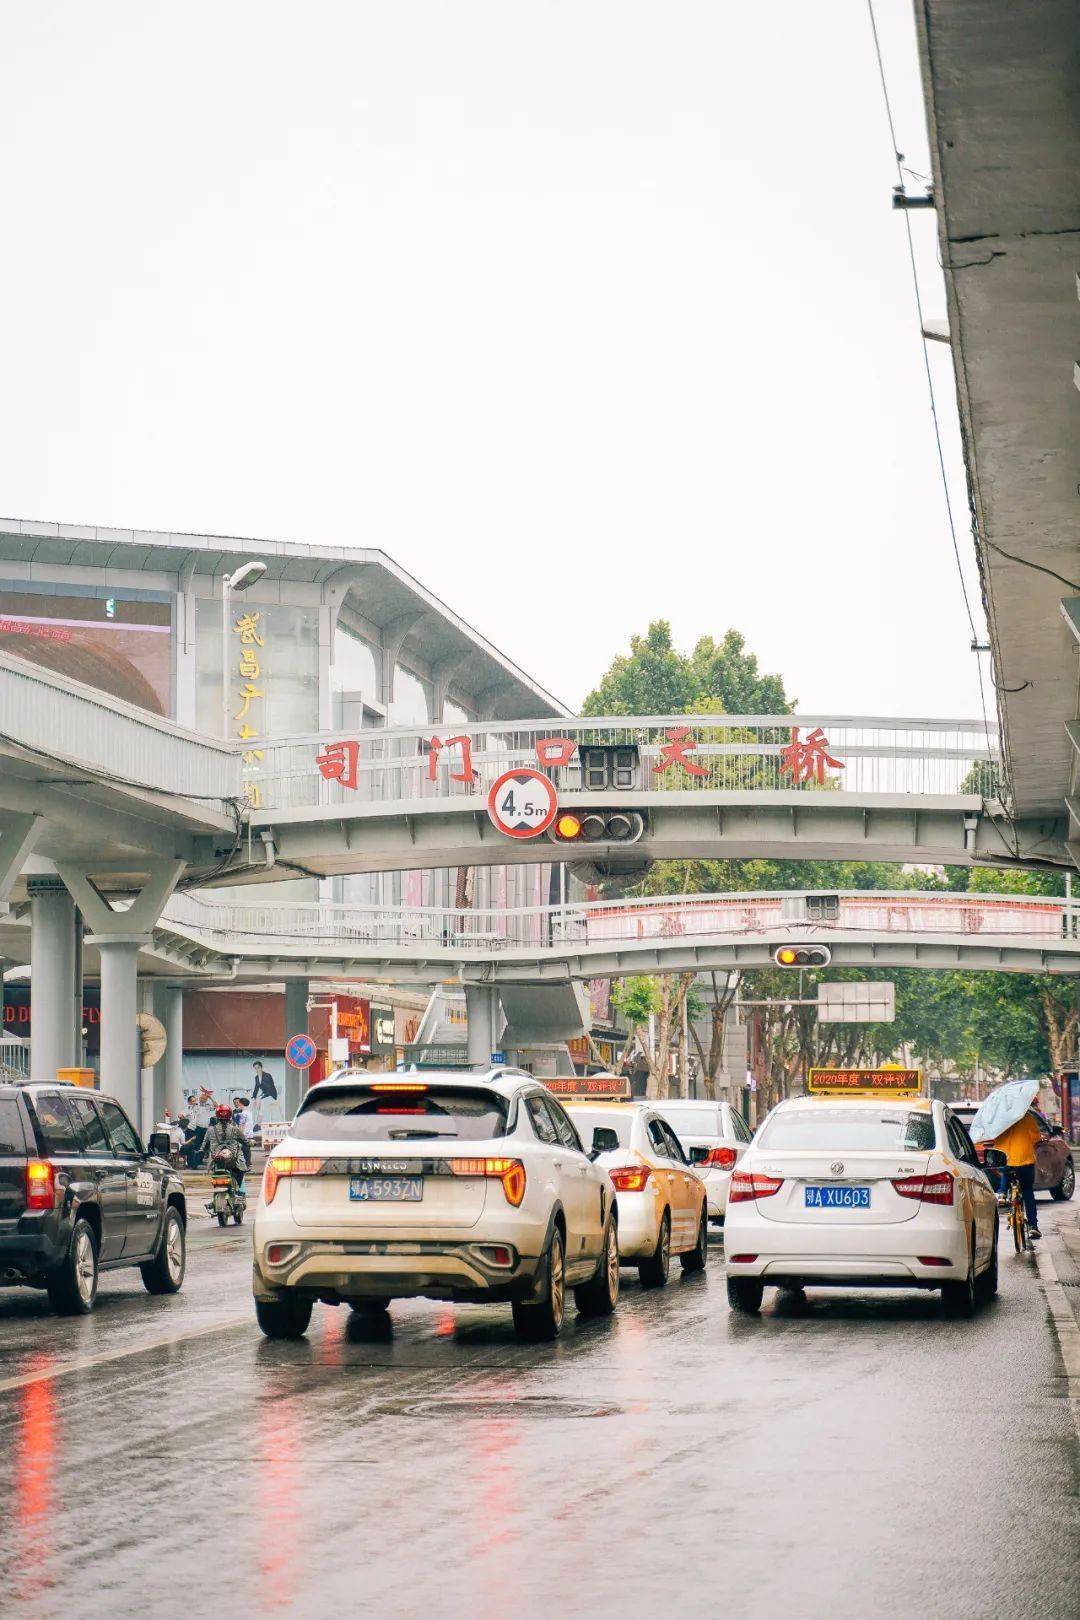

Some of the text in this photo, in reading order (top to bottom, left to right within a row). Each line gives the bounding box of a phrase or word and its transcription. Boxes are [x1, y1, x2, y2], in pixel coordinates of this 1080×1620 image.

[316, 726, 845, 790] 司门口天桥
[501, 789, 548, 817] 4.5m
